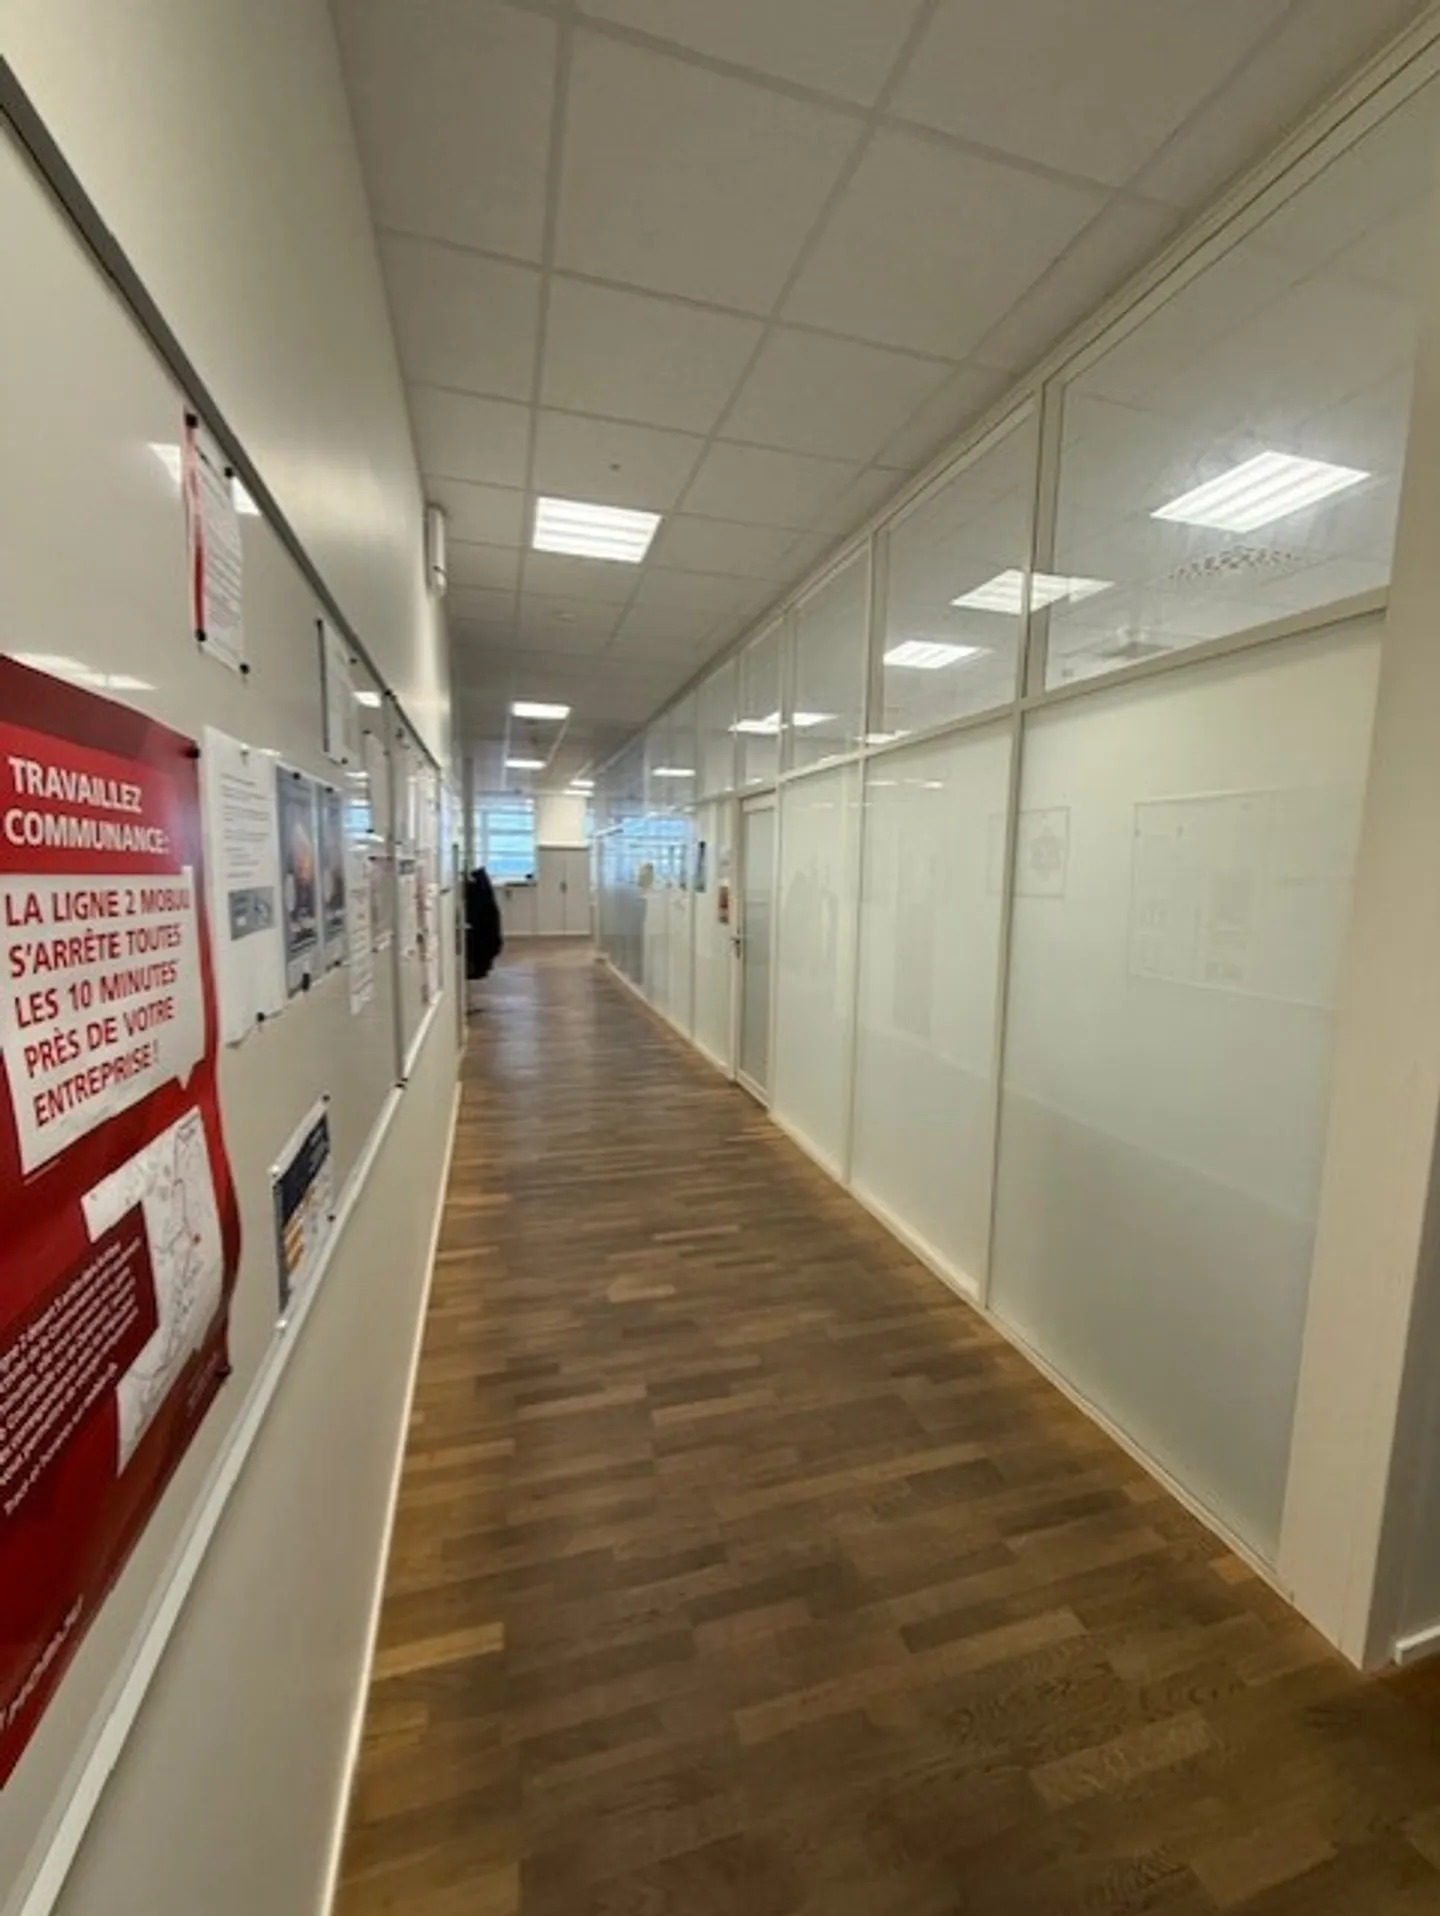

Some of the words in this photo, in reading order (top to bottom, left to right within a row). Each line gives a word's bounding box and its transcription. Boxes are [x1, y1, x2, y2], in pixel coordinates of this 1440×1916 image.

[8, 756, 142, 814] TRAVAILLEZ
[5, 892, 43, 926] LA
[52, 889, 119, 921] LIGNE
[125, 889, 136, 914] 2
[126, 922, 182, 956] TOUTES
[15, 987, 59, 1028] LES
[69, 979, 92, 1011] 10
[100, 959, 178, 1003] MINUTES
[24, 1027, 80, 1079] PRÈS
[87, 1016, 118, 1050] DE
[123, 996, 175, 1037] VOTRE
